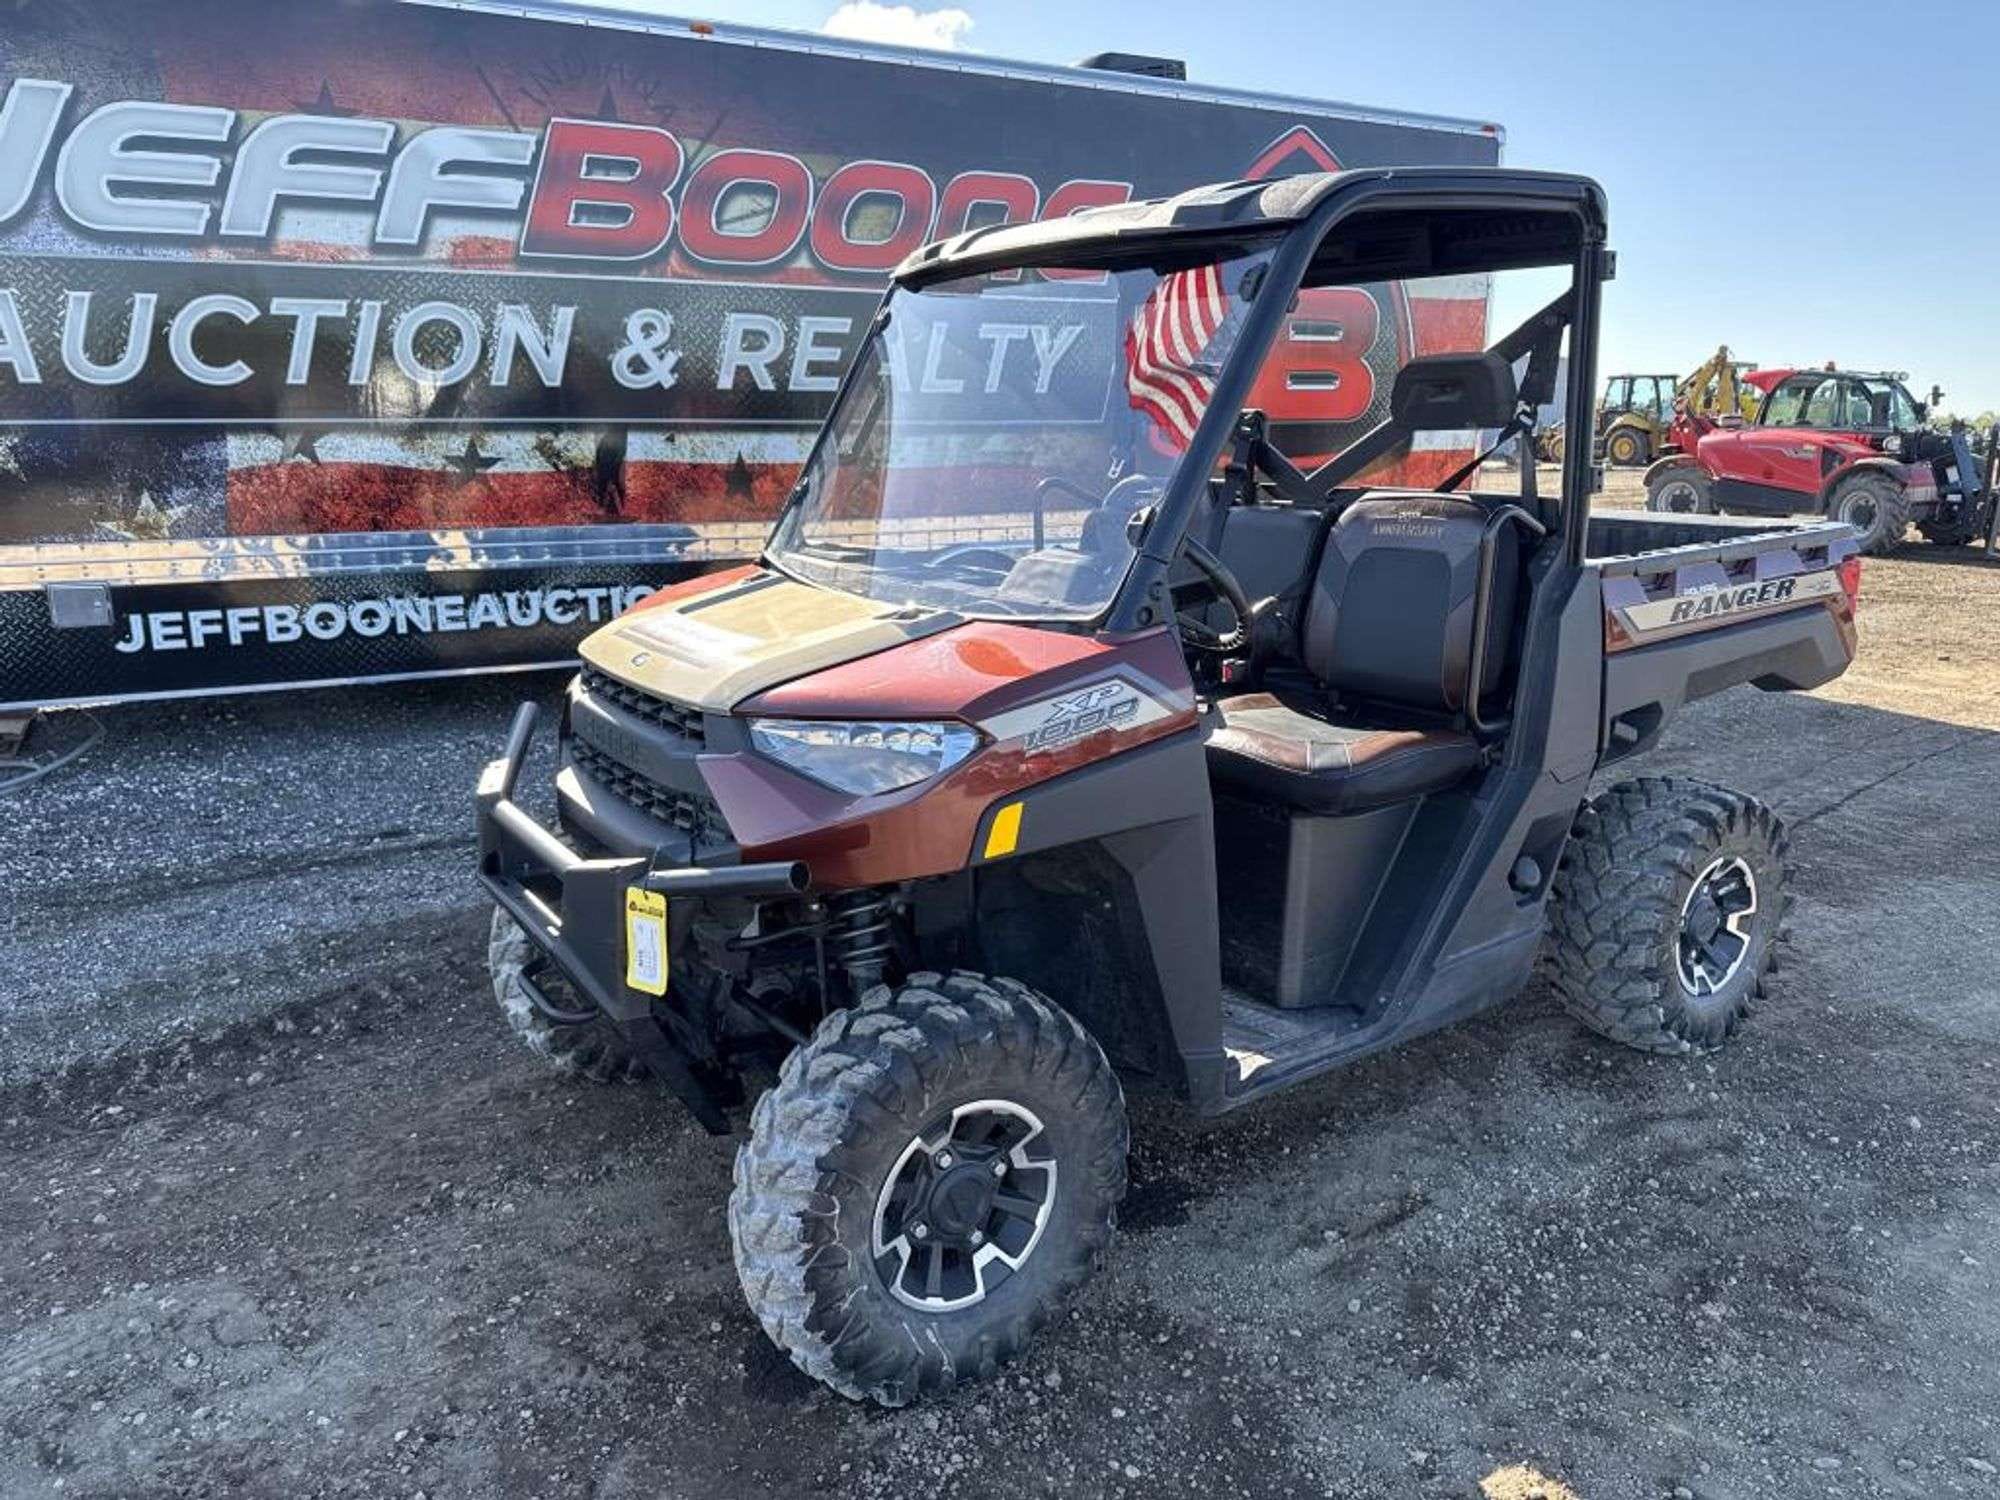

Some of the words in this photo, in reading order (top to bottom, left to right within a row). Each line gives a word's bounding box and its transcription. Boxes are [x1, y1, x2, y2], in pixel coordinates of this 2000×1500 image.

[610, 308, 682, 389] &
[115, 583, 672, 654] JEFFBOONEAUCTIO
[1670, 577, 1797, 622] RANGER
[1043, 683, 1125, 725] XP
